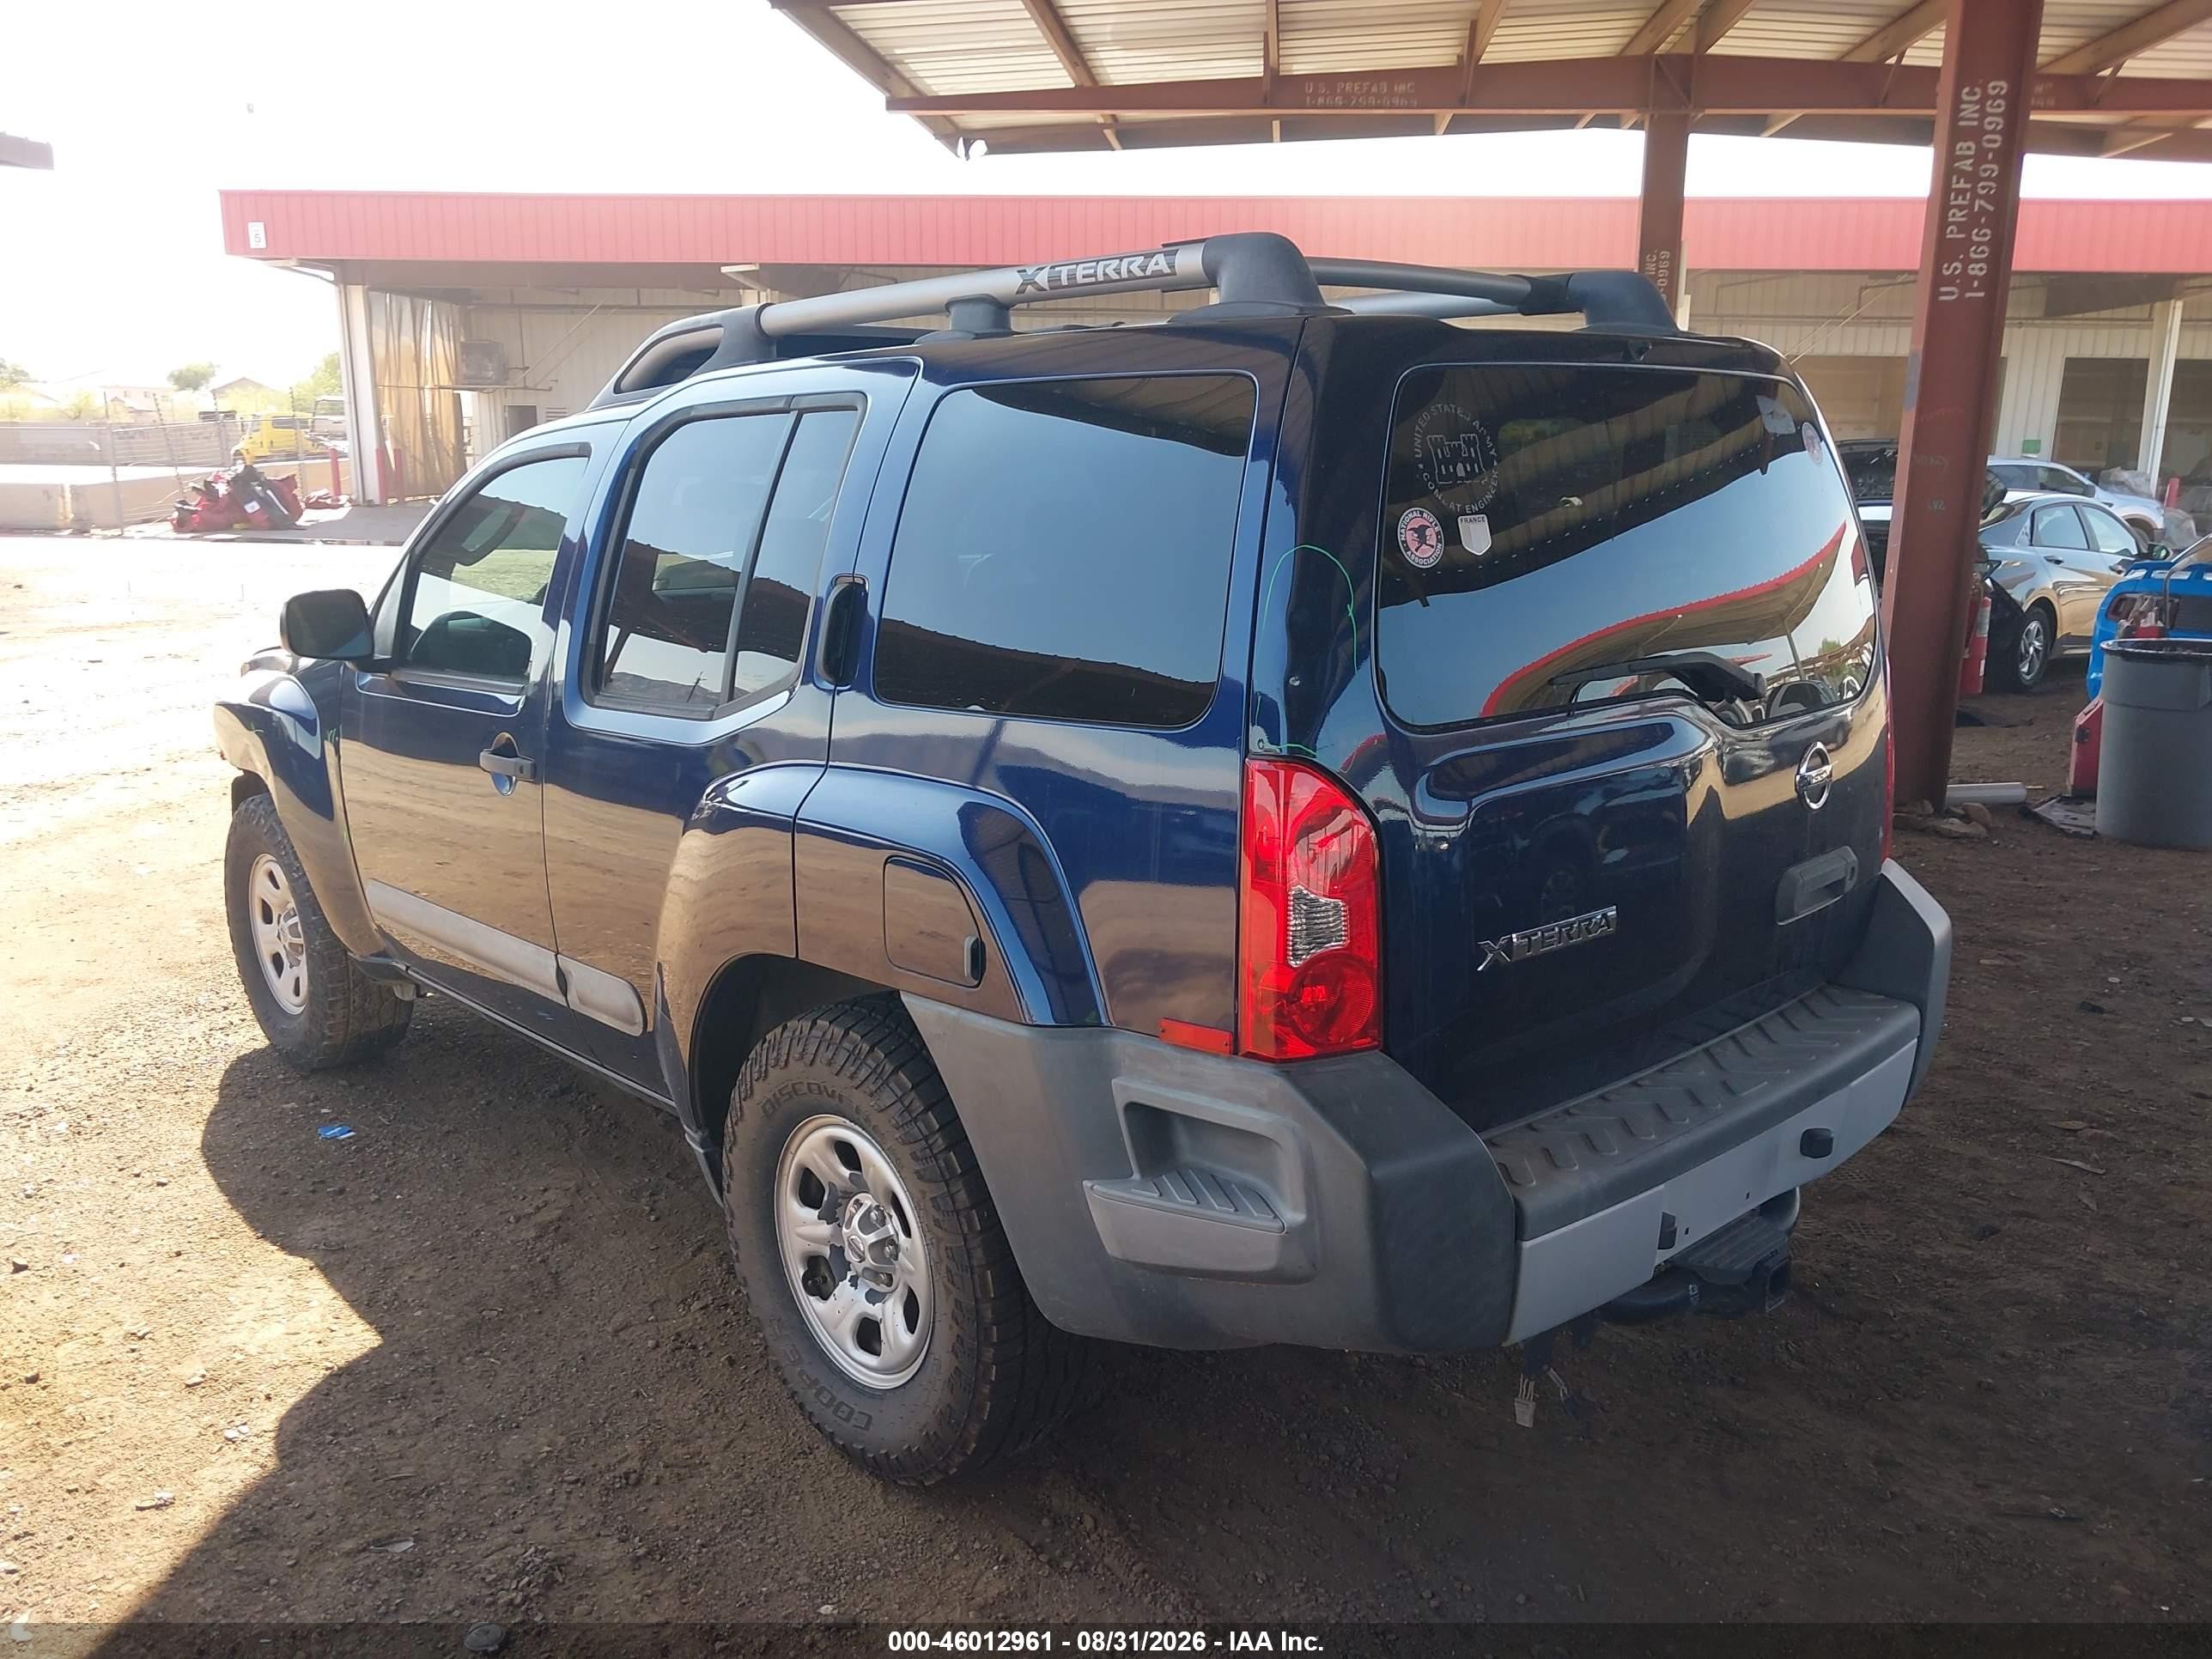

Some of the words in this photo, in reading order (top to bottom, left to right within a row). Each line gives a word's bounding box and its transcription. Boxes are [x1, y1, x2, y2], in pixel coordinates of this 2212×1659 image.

[1336, 82, 1387, 94] PREFAB
[1946, 141, 1976, 240] PREFAB
[1965, 80, 2008, 299] 1-866-799-0969
[1015, 252, 1172, 295] XTERRA
[1939, 254, 1965, 301] U.S.
[1414, 411, 1431, 459] UNITED
[1399, 510, 1422, 541] NATIONAL
[1422, 513, 1440, 532] RIFLE
[1406, 542, 1443, 566] ASSOCIATION
[1477, 906, 1617, 971] XTERRA
